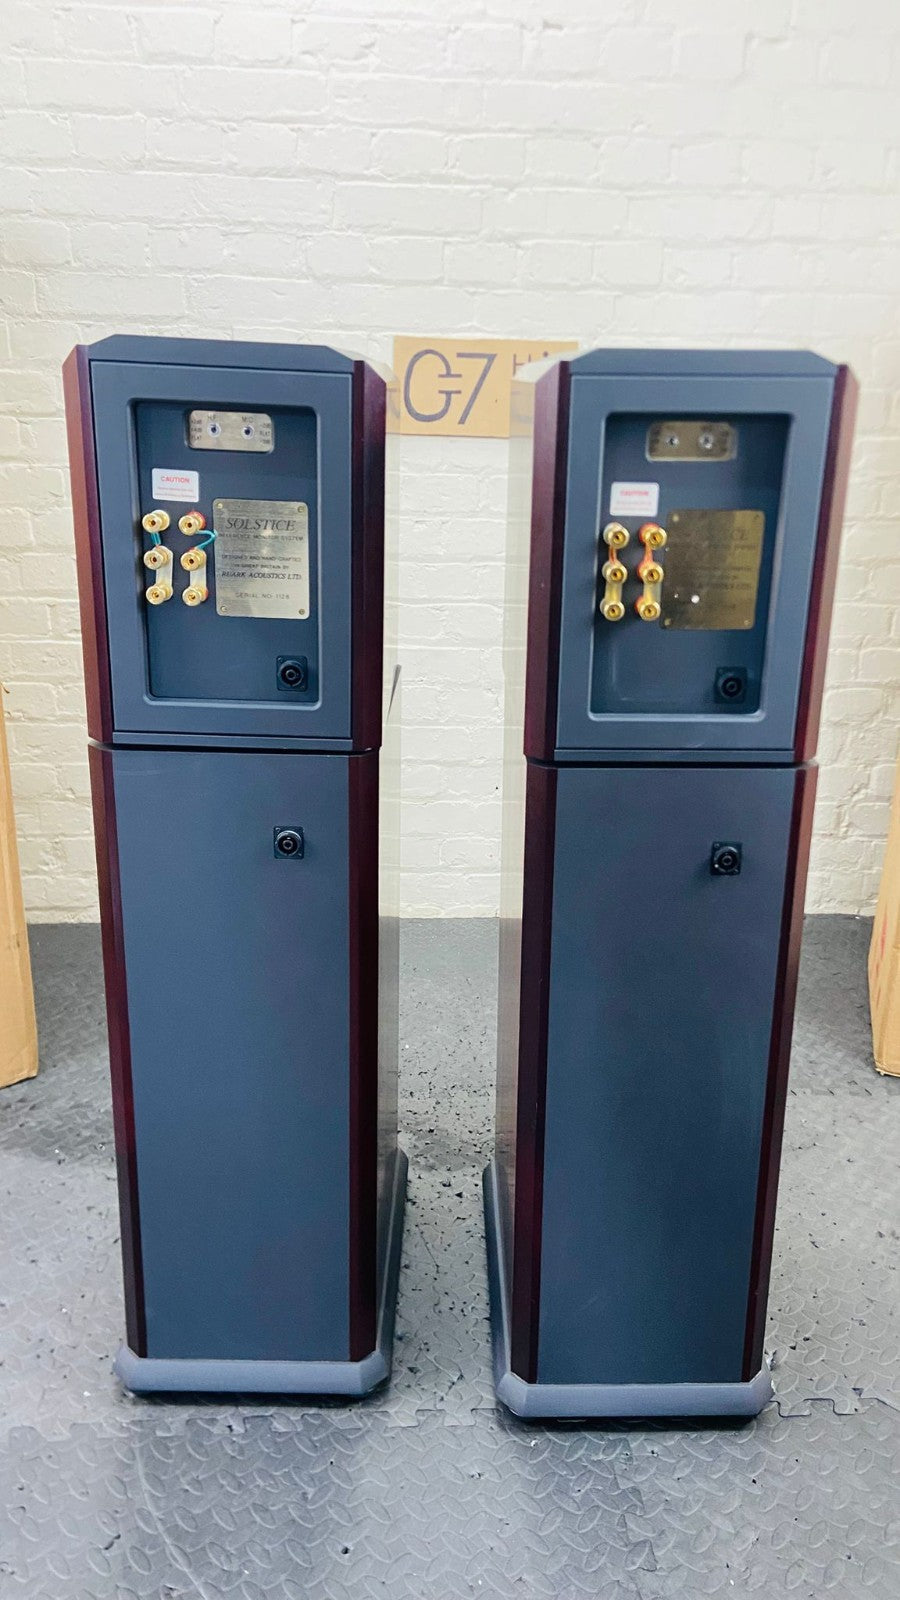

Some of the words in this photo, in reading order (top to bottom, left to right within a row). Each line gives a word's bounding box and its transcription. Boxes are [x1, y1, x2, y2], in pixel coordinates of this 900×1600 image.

[403, 348, 498, 426] G7
[160, 475, 191, 483] CAUTION
[225, 518, 296, 531] SOLSTICE
